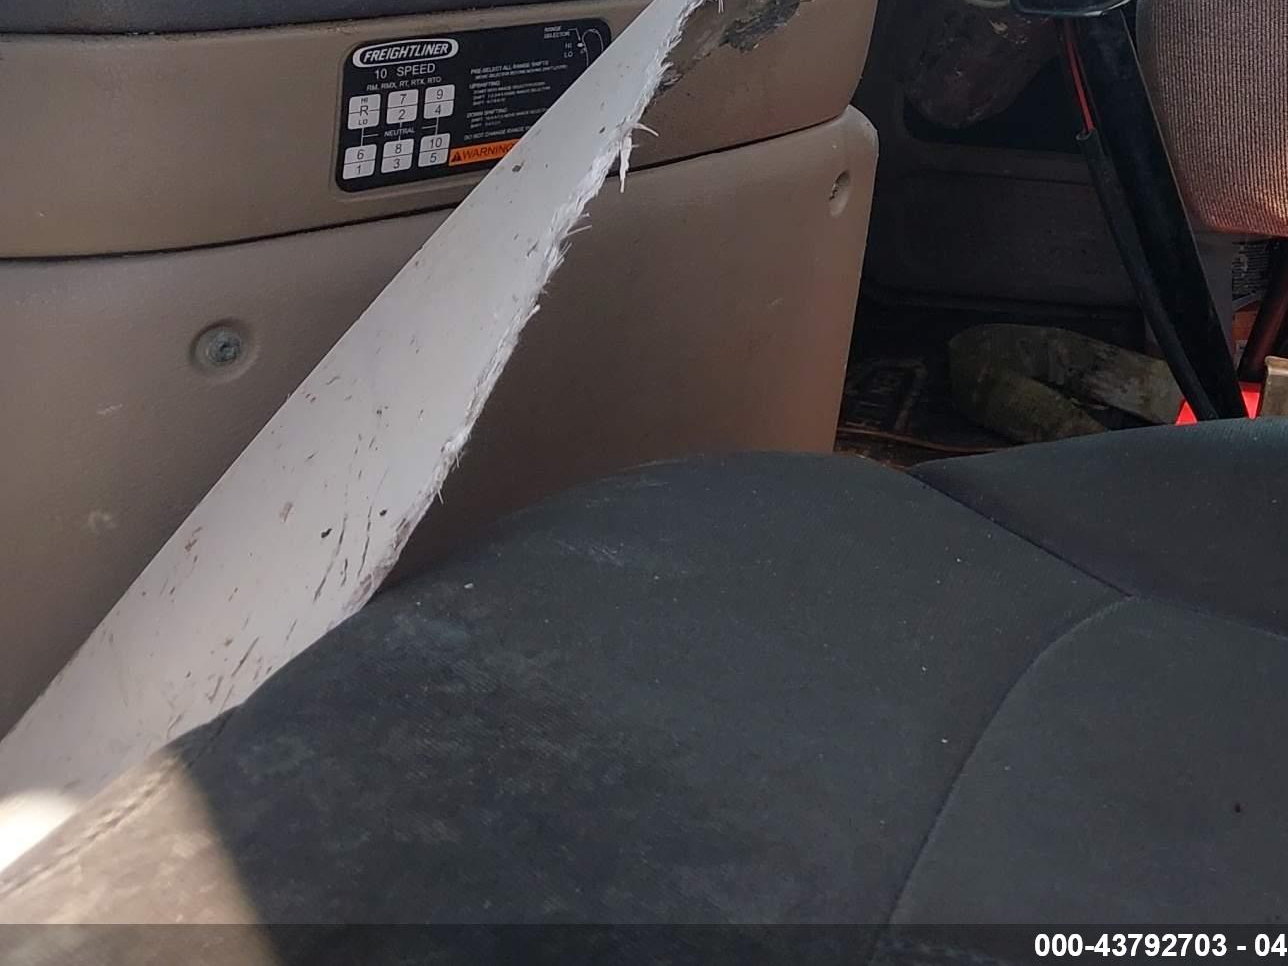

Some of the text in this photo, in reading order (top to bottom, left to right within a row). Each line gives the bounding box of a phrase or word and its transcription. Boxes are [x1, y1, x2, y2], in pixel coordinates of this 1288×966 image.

[363, 43, 448, 62] FREIGHTLINER
[374, 63, 435, 80] 10 SPEED
[400, 94, 407, 104] 7
[437, 89, 444, 99] 9
[360, 106, 369, 116] R
[398, 109, 406, 120] 2
[434, 105, 441, 115] 4
[358, 118, 368, 126] LO
[384, 127, 415, 137] NEUTRAL
[430, 137, 442, 148] 10
[395, 144, 402, 154] 8
[357, 149, 364, 160] 6
[430, 153, 437, 163] 5
[393, 159, 400, 169] 3
[356, 165, 361, 175] 1
